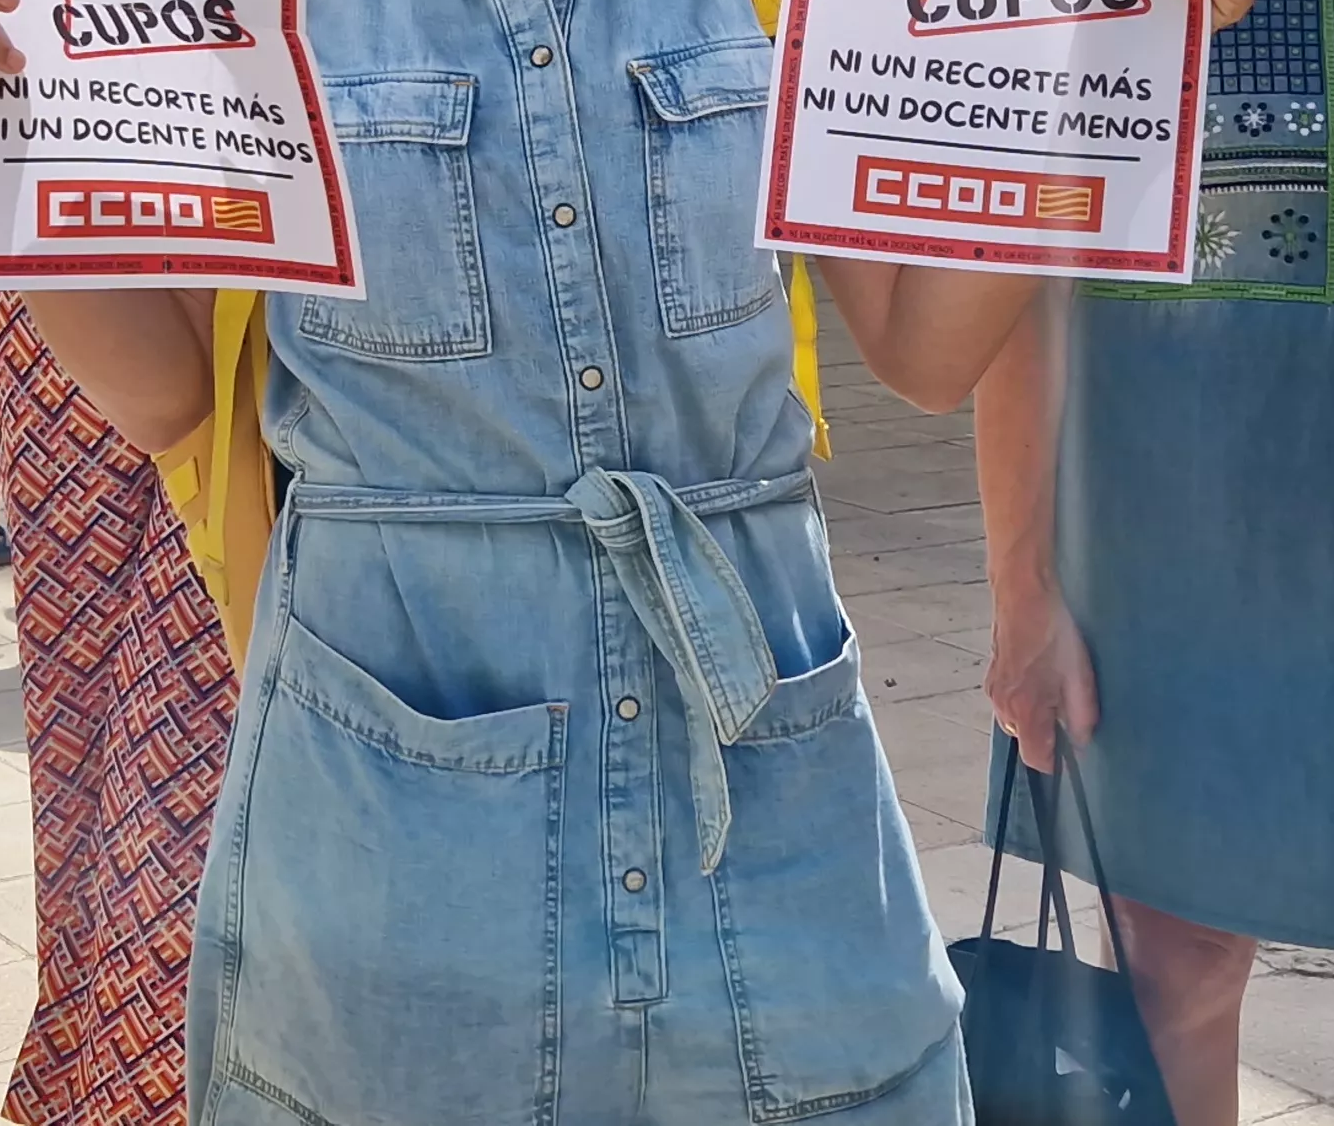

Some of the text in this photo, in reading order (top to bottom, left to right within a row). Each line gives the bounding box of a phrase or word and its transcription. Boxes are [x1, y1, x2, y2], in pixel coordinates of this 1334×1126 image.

[831, 50, 1151, 100] NI UN RECORTE MÁS
[0, 76, 284, 125] NI UN RECORTE MÁS
[804, 88, 1170, 141] NI UN DOCENTE MENOS
[19, 117, 61, 140] UN
[74, 118, 206, 149] DOCENTE
[216, 130, 313, 163] MENOS
[48, 191, 204, 228] CCOO
[866, 168, 1026, 216] CCOO
